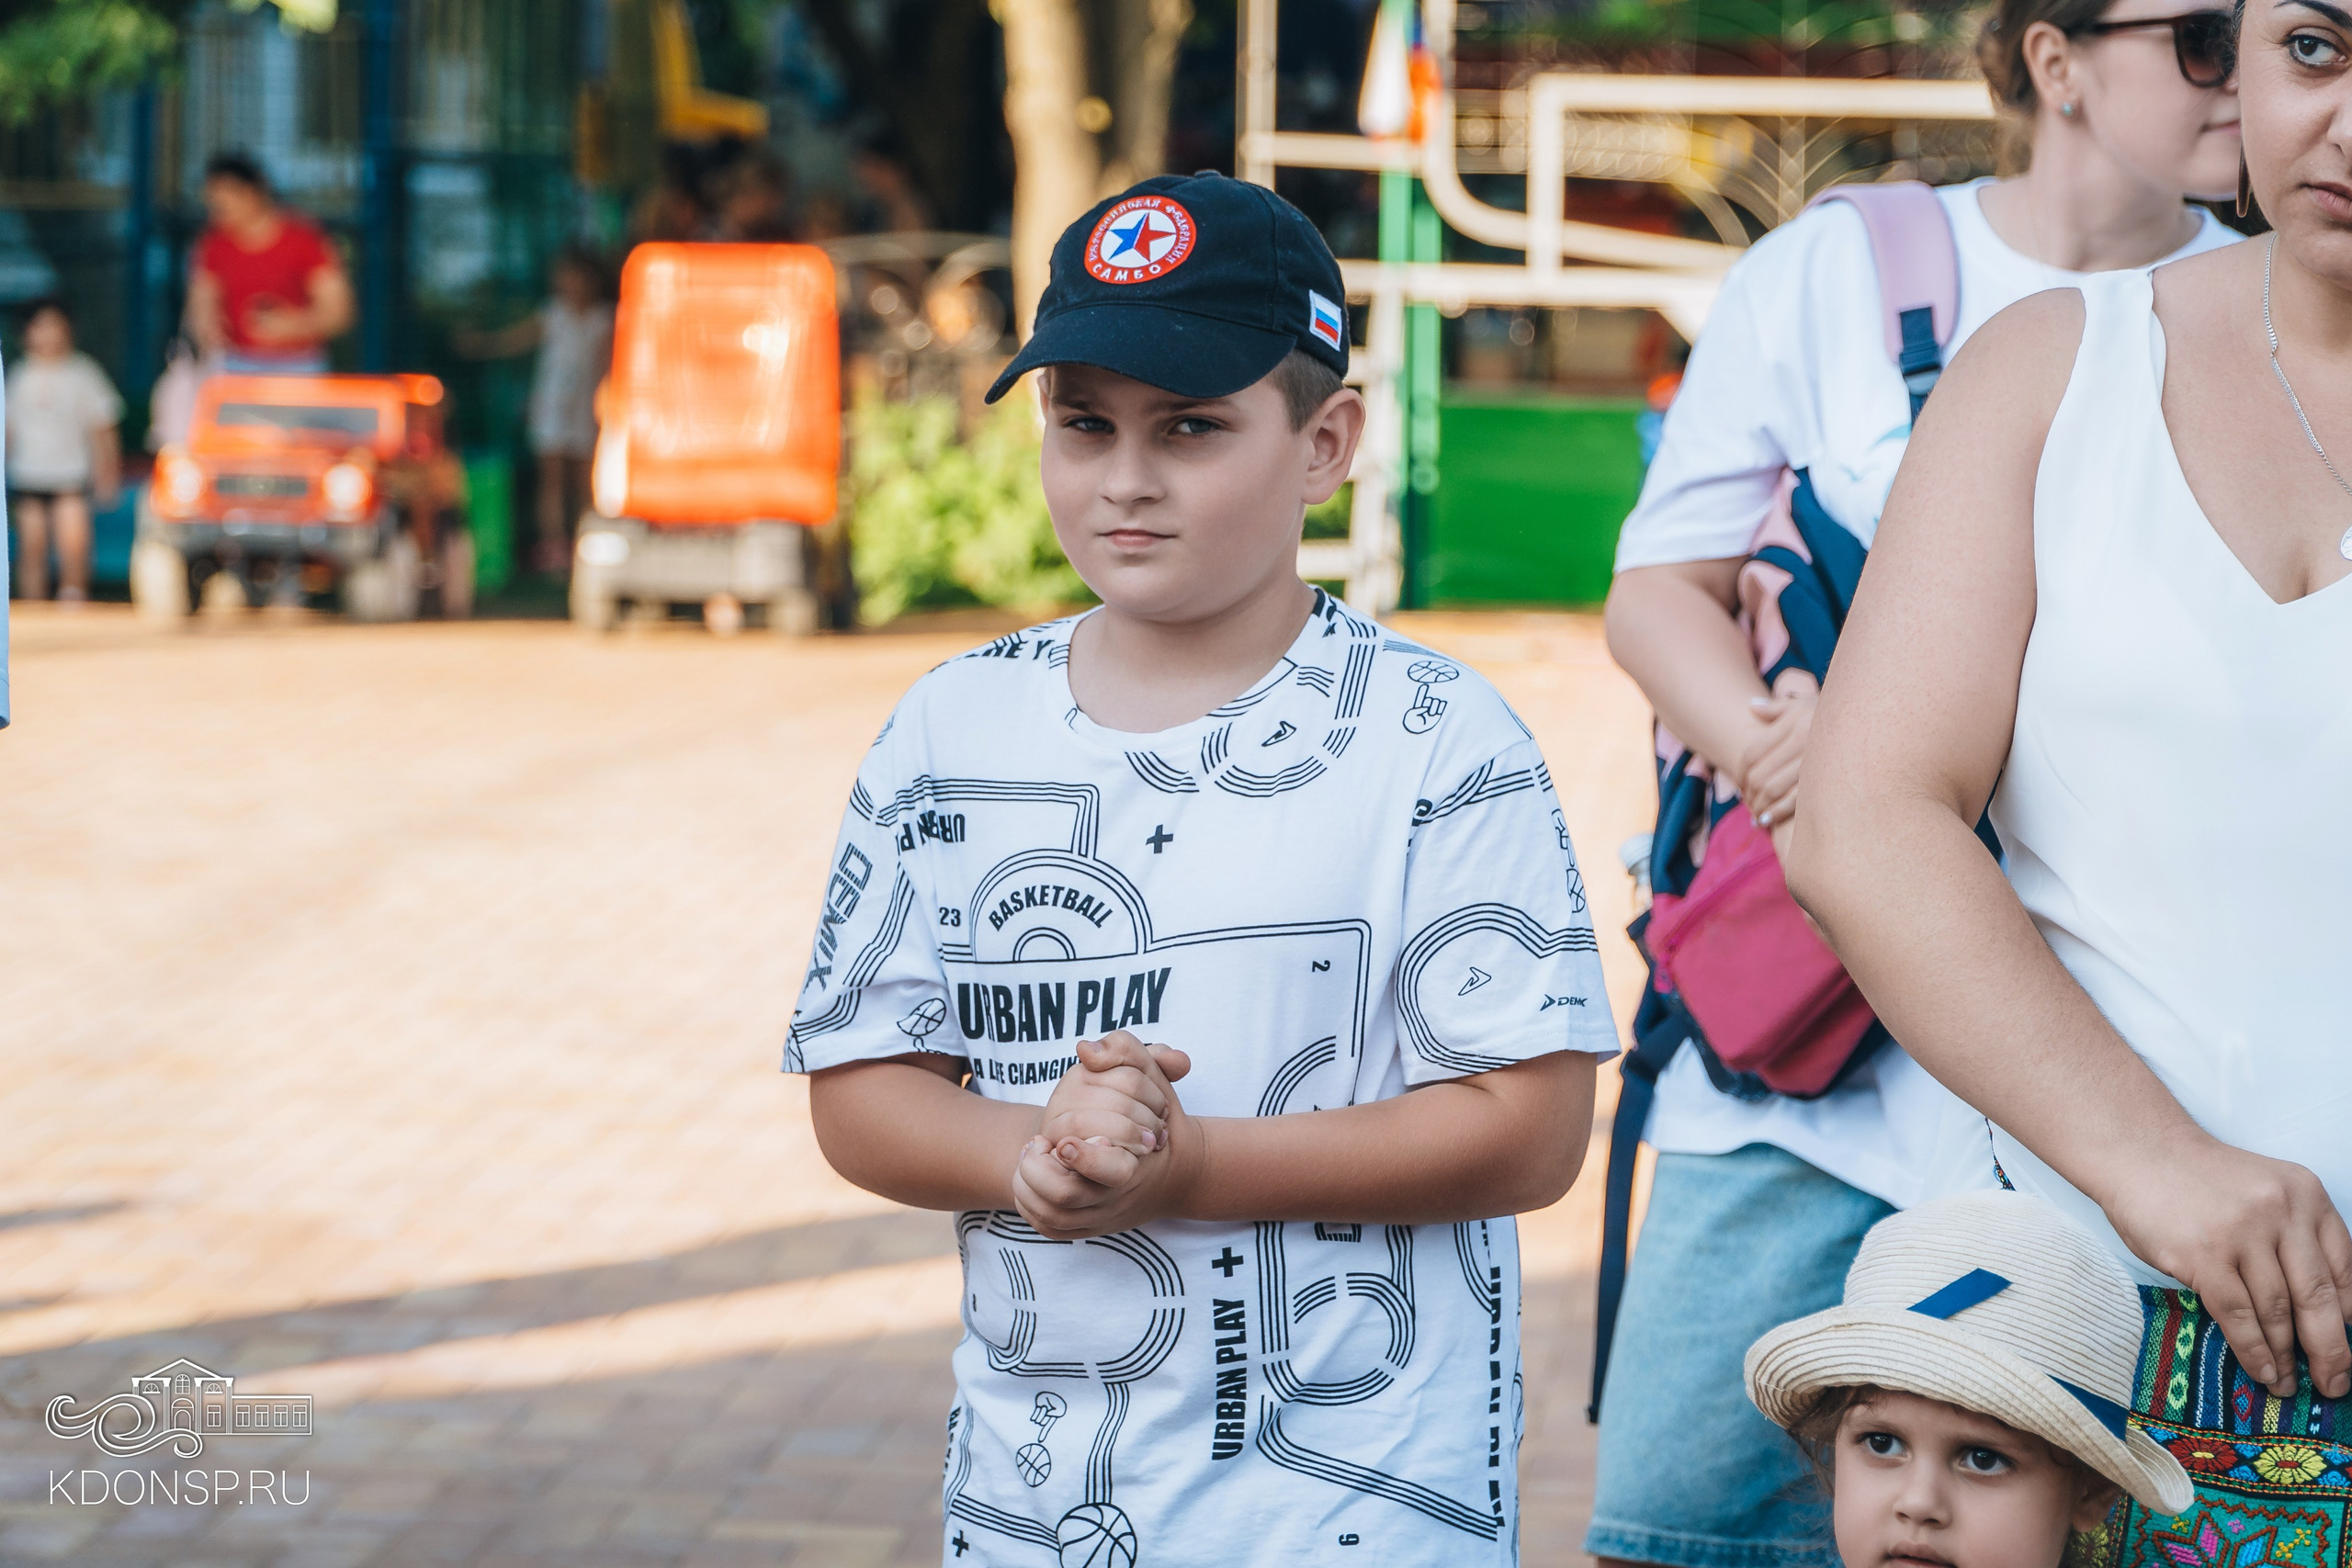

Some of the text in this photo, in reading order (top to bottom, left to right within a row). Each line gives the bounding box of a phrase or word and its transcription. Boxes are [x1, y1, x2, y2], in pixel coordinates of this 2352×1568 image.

[1091, 263, 1162, 282] САМБО
[939, 907, 961, 927] 23
[989, 885, 1113, 931] BASKETBALL
[1311, 959, 1330, 973] 2
[957, 967, 1172, 1043] URBAN PLAY
[974, 1057, 985, 1079] A
[1212, 1298, 1248, 1461] URBAN PLAY
